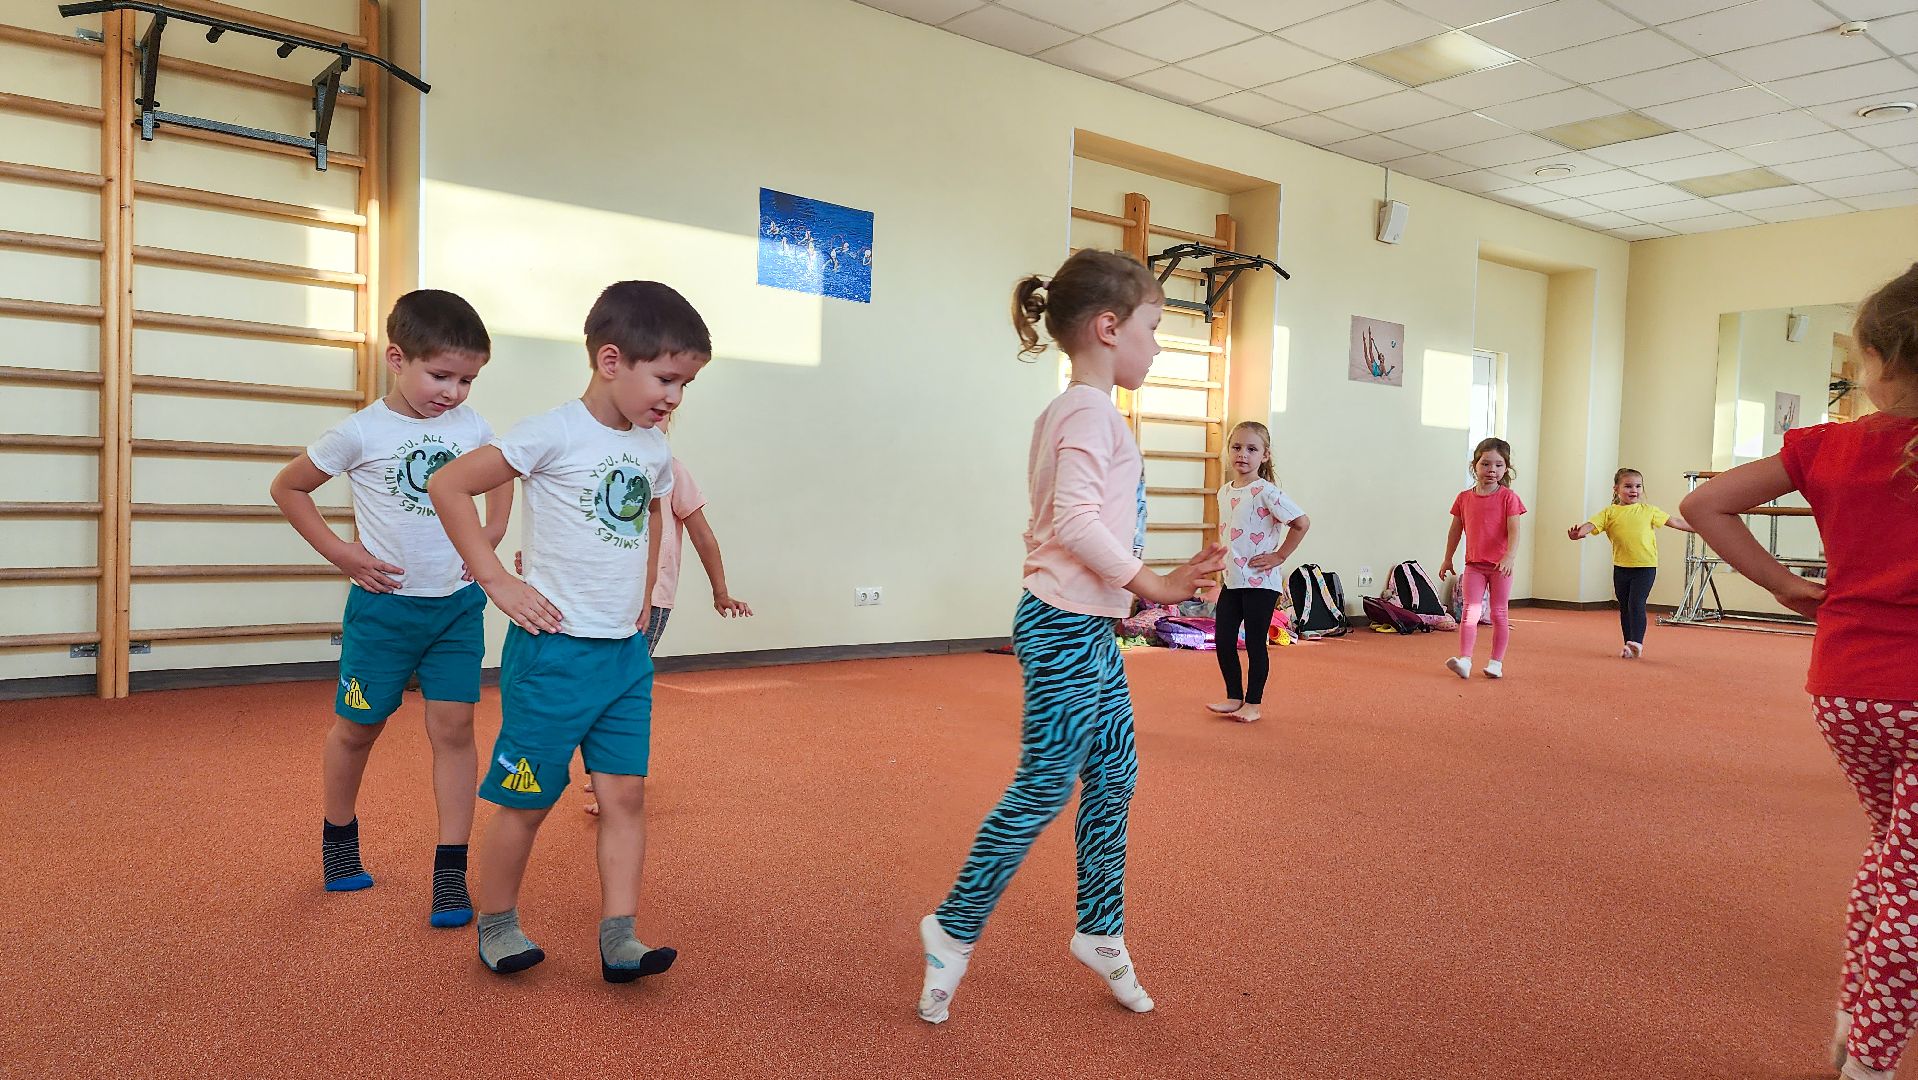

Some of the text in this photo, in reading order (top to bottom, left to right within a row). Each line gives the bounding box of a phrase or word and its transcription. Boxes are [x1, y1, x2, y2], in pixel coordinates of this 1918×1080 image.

[422, 433, 444, 444] ALL
[450, 441, 463, 456] TH
[622, 452, 640, 466] ALL
[384, 467, 400, 496] WITH
[399, 499, 437, 517] MILES
[579, 487, 596, 521] WITH
[594, 527, 640, 550] SMILES
